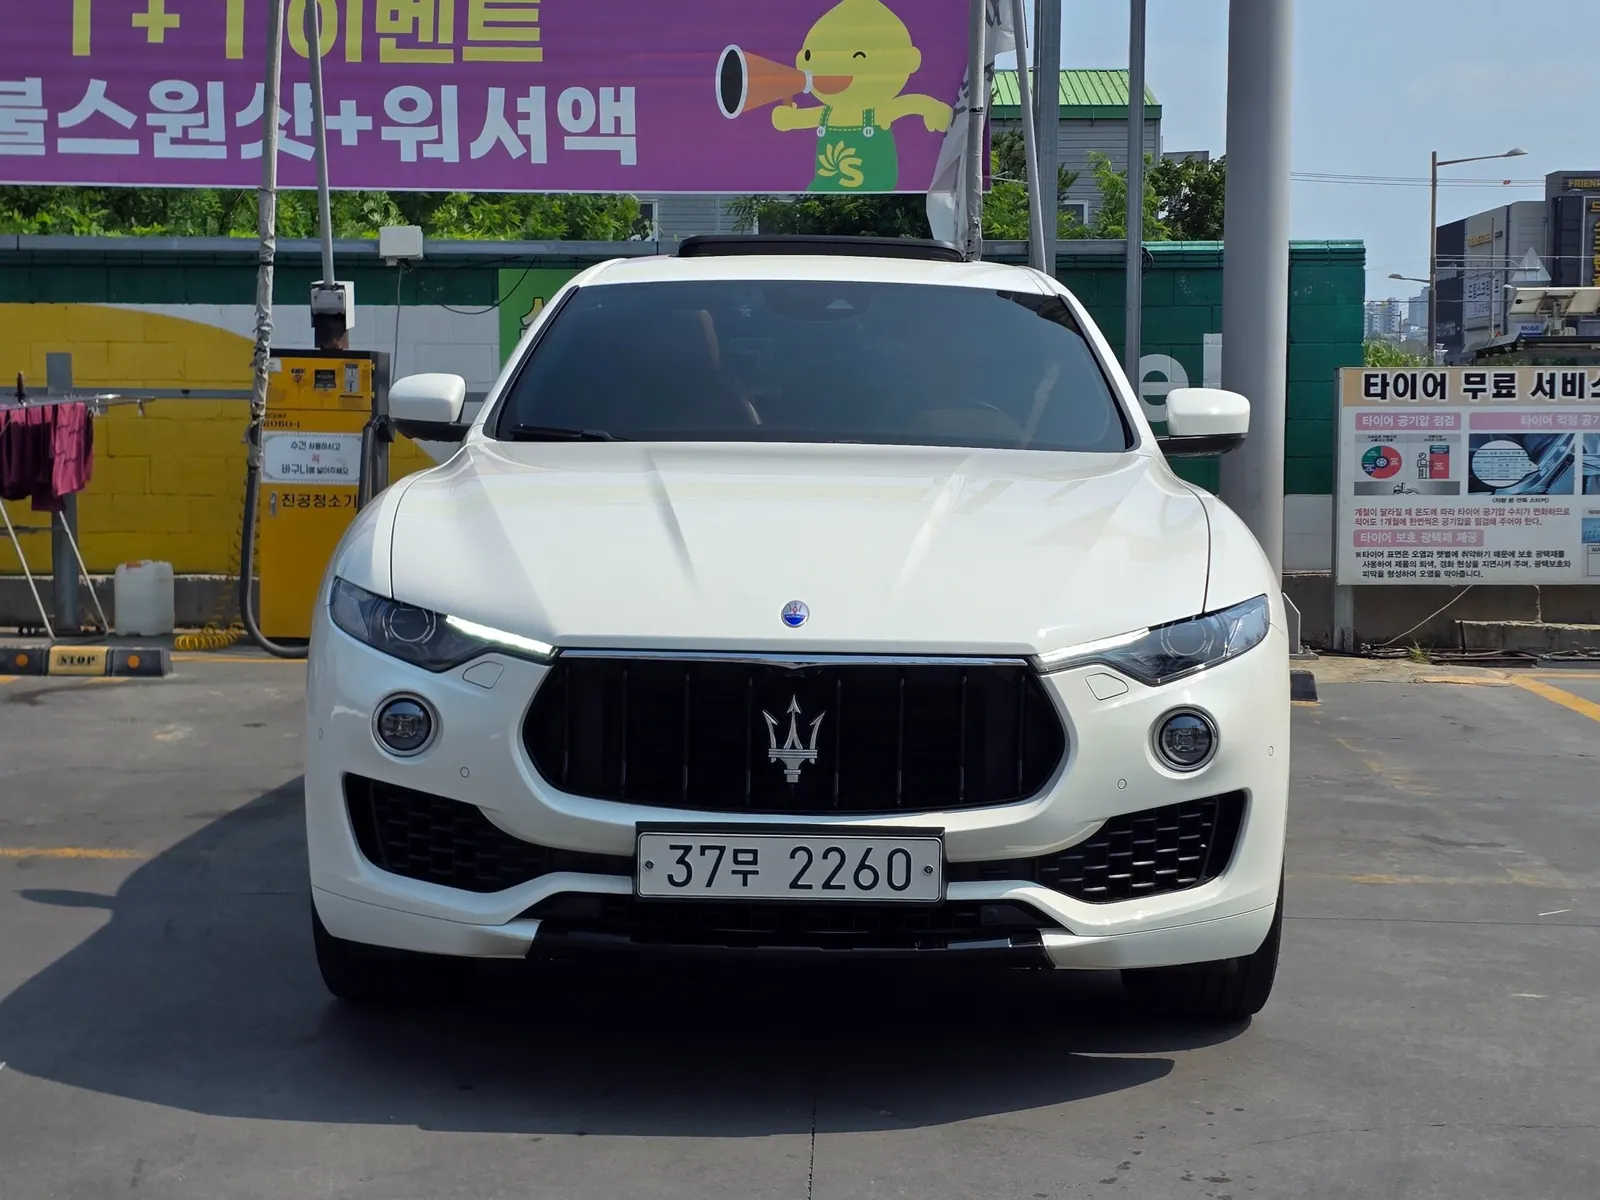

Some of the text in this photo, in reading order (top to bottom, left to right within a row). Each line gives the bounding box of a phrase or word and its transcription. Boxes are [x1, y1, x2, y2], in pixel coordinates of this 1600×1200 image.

[287, 0, 543, 63] 이벤트
[1364, 373, 1447, 400] 타이어
[1462, 373, 1517, 399] 무료
[1362, 415, 1454, 427] 타이어 공기압 점검
[1520, 414, 1552, 427] 타이어
[1557, 414, 1578, 427] 적정
[291, 440, 341, 451] 수건 사용하시고
[281, 464, 316, 474] 바구니에
[282, 493, 357, 508] 진공청소기
[1355, 508, 1571, 516] 계절이 달라질 때 온도에 따라 타이어 공기압 수치가 변화하므로
[1355, 518, 1377, 526] 적어도
[1380, 518, 1406, 526] 1개월에
[1441, 518, 1472, 526] 공기압을
[1474, 518, 1497, 526] 점검해
[1499, 518, 1522, 526] 주어야
[1361, 532, 1477, 543] 타이어 보호 광택제 제공
[1536, 550, 1565, 558] 광택제를
[1482, 560, 1511, 568] 지연시켜
[1534, 560, 1571, 568] 광택보호와
[1362, 570, 1484, 578] 피막을 형성하여 오염을 막아줍니다.
[60, 655, 96, 665] STOP
[666, 844, 912, 892] 37무 2260
